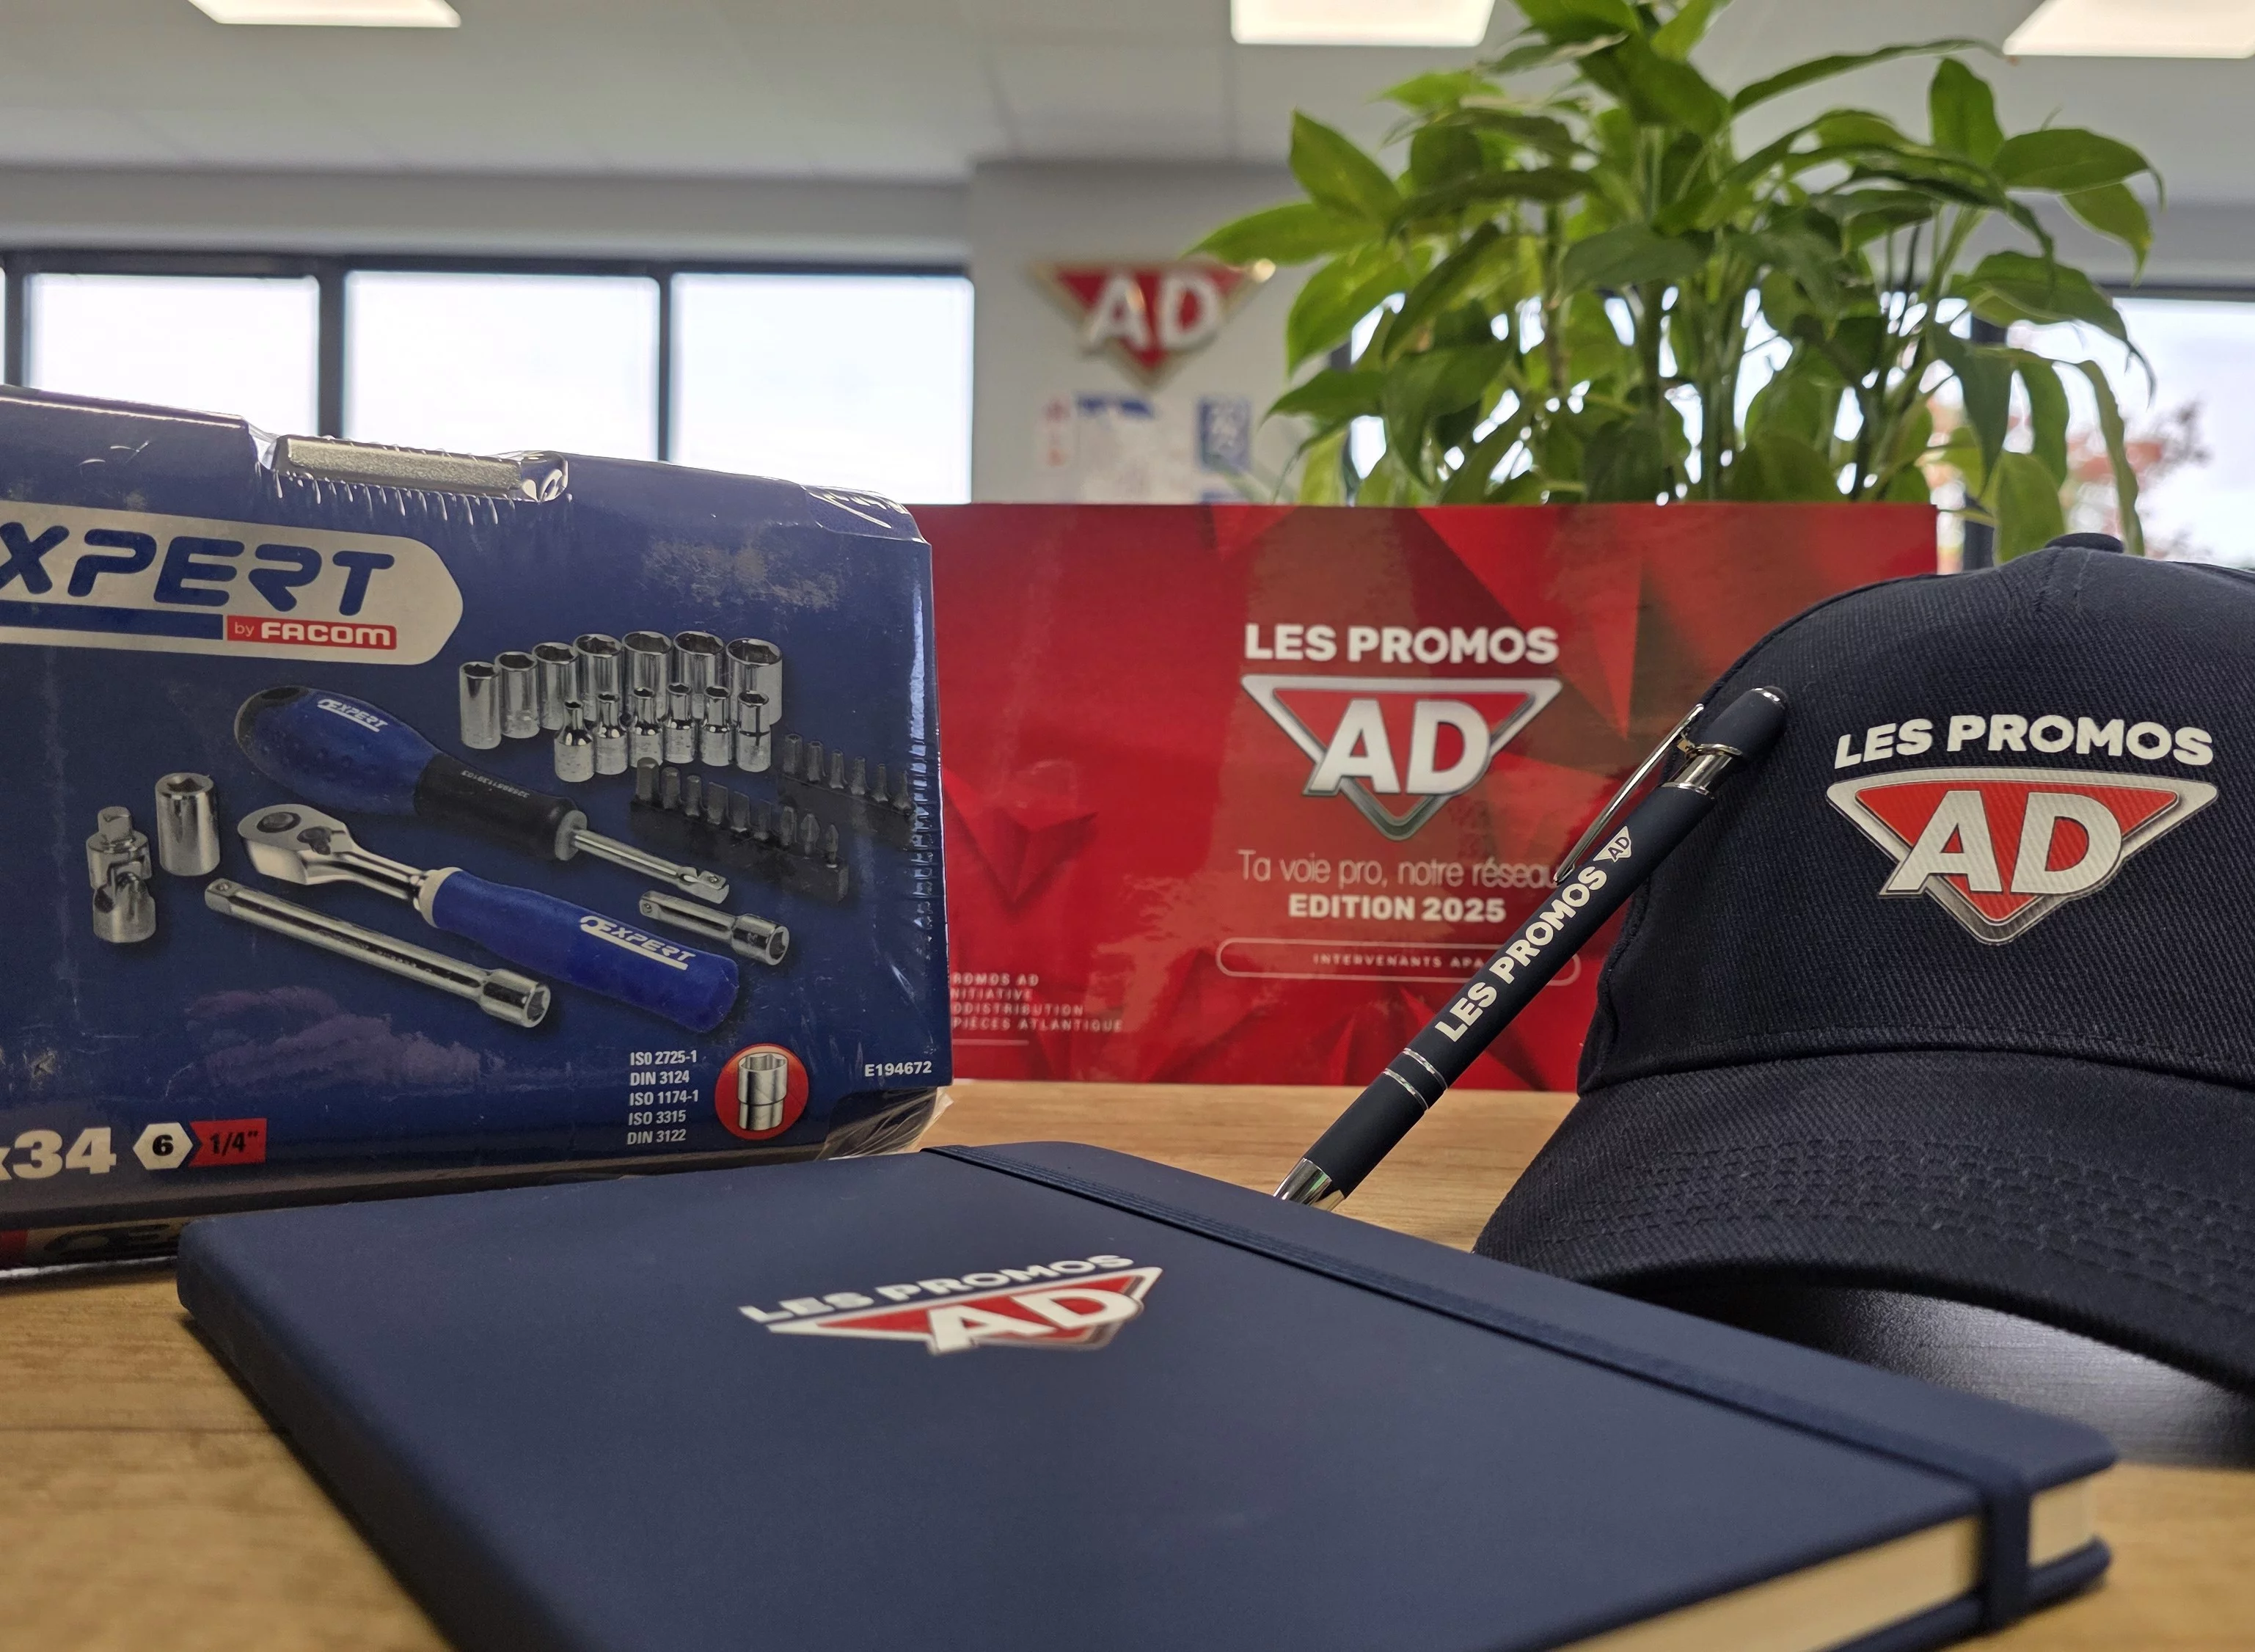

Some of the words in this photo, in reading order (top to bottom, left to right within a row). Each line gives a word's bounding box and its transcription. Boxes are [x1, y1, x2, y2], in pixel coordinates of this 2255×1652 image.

[1082, 274, 1222, 351] AD
[234, 622, 255, 637] by
[261, 621, 390, 646] FACOM
[1245, 624, 1337, 661] LES
[1348, 626, 1560, 664] PROMOS
[317, 698, 388, 729] EXPERT
[1303, 698, 1491, 794] AD
[1834, 718, 1934, 769] LES
[1947, 714, 2214, 766] PROMOS
[1882, 789, 2124, 894] AD
[1238, 849, 1271, 881] Ta
[1279, 852, 1331, 884] voie
[1339, 858, 1388, 890] pro,
[1398, 859, 1465, 888] notre
[1288, 894, 1415, 922] EDITION
[1422, 897, 1507, 924] 2025
[580, 915, 696, 963] EXPERT
[1435, 982, 1497, 1042] LES
[1488, 866, 1607, 984] PROMOS
[1607, 836, 1630, 860] AD
[1312, 953, 1442, 968] INTERVENANTS
[1015, 973, 1039, 987] AD
[1017, 1017, 1122, 1033] ATLANTIQUE
[630, 1051, 652, 1065] ISO
[654, 1050, 697, 1064] 2725-1
[864, 1061, 932, 1077] E194672
[630, 1072, 657, 1086] DIN
[659, 1070, 690, 1084] 3124
[629, 1092, 654, 1105] ISO
[657, 1089, 698, 1104] 1174-1
[628, 1111, 653, 1125] ISO
[656, 1110, 686, 1124] 3315
[152, 1134, 174, 1156] 6
[627, 1130, 653, 1144] DIN
[656, 1129, 686, 1142] 3122
[739, 1292, 874, 1323] LES
[876, 1254, 1135, 1301] PROMOS
[927, 1288, 1144, 1356] AD
